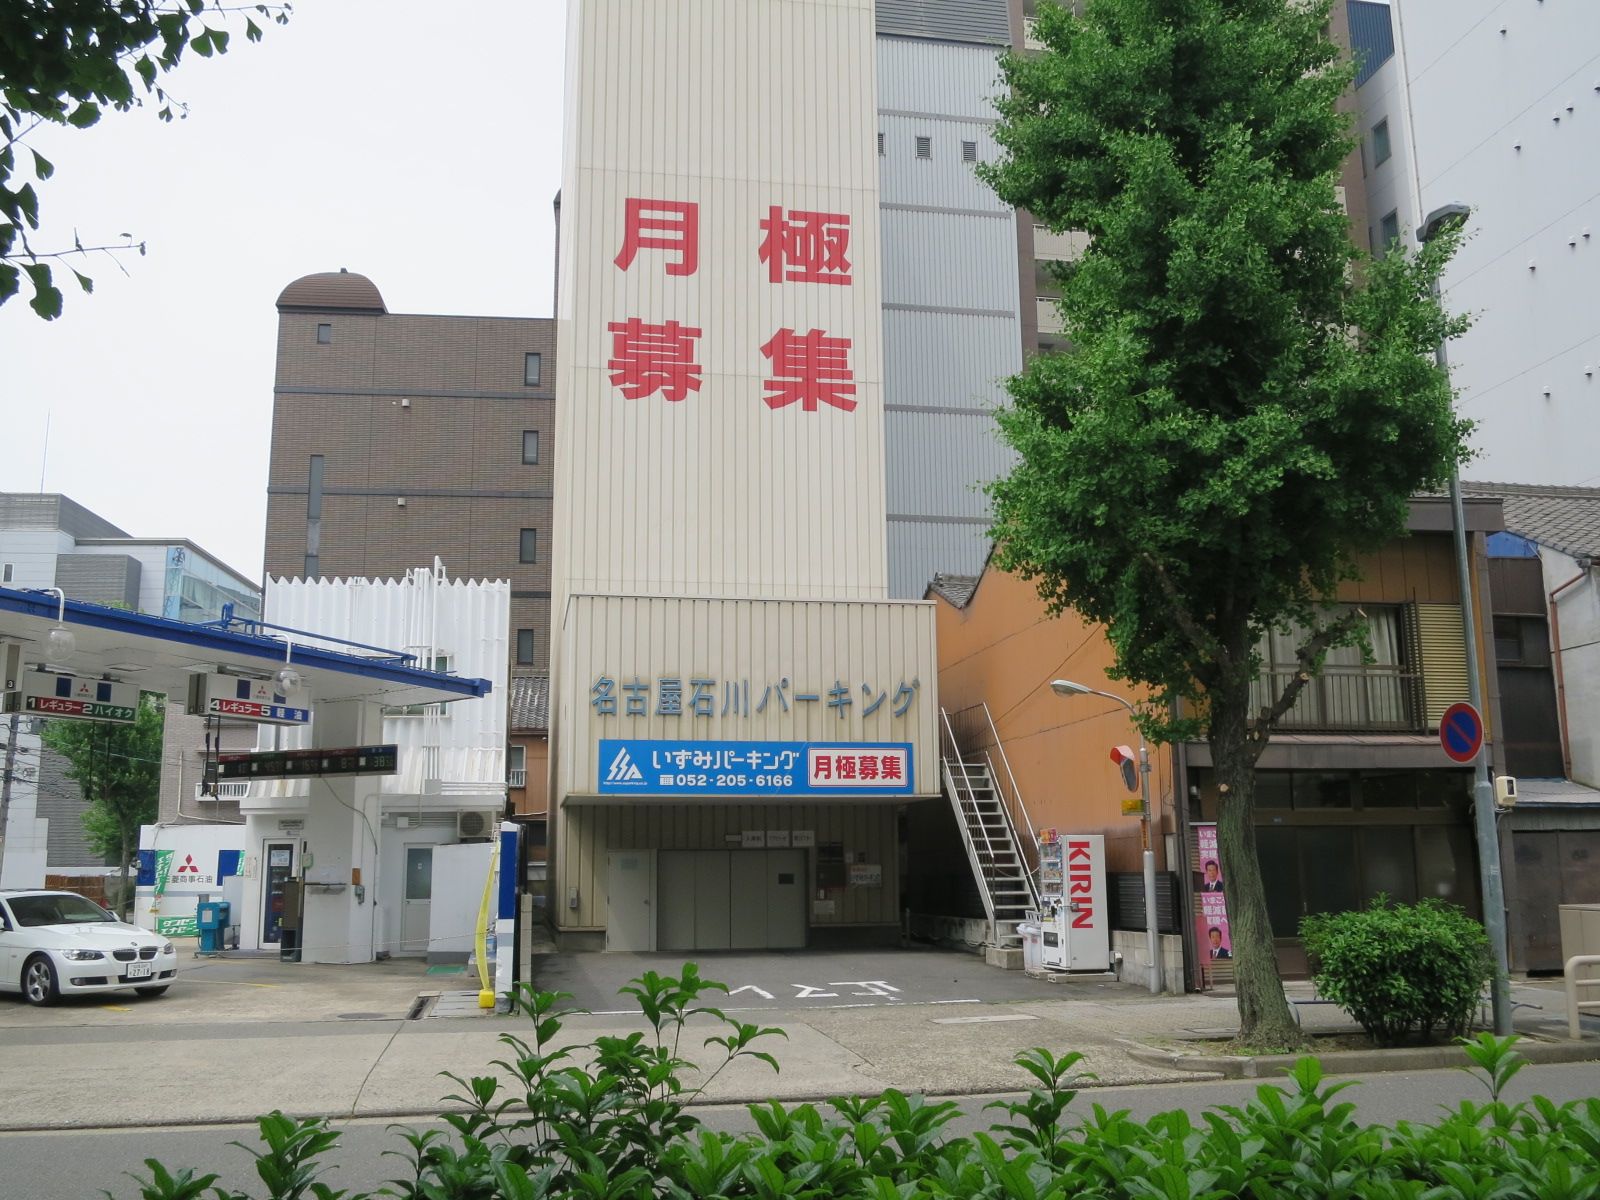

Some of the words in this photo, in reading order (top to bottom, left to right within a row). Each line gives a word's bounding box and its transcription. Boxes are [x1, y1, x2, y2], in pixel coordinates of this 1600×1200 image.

[613, 197, 852, 286] 月極
[607, 317, 858, 412] 募集
[27, 697, 36, 709] 1
[40, 699, 81, 712] レギュラー
[82, 703, 93, 714] 2
[95, 705, 133, 718] ハイオク
[210, 699, 220, 710] 4
[222, 702, 260, 714] レギュラー
[261, 706, 271, 717] 5
[591, 674, 920, 719] 名古屋石川パーキング
[653, 749, 800, 770] いずみパーキング
[814, 755, 902, 780] 月極募集
[1068, 841, 1094, 929] KIRIN
